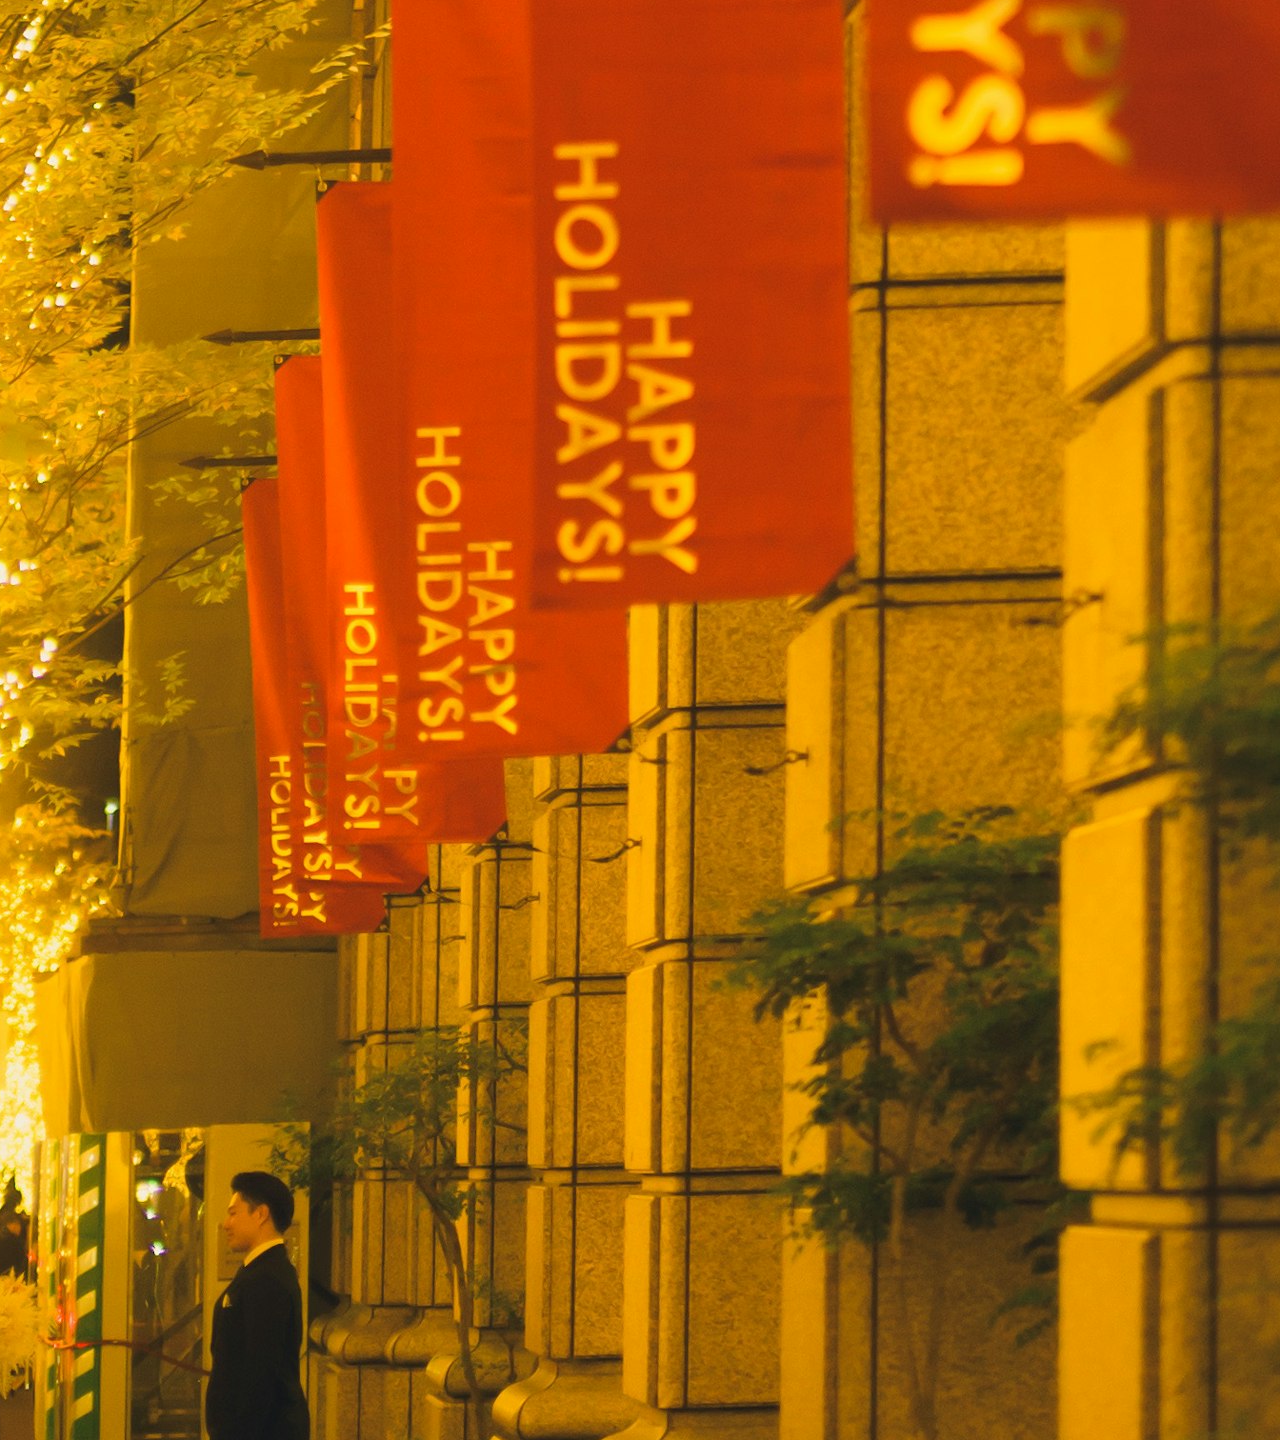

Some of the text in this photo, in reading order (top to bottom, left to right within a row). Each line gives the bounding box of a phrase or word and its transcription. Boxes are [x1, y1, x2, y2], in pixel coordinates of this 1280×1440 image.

[554, 142, 623, 584] HOLIDAYS!
[626, 300, 698, 575] HAPPY
[343, 583, 381, 831] HOLIDAYS!
[415, 425, 465, 742] HOLIDAYS!
[467, 540, 518, 736] HAPPY
[269, 754, 299, 927] HOLIDAYS!
